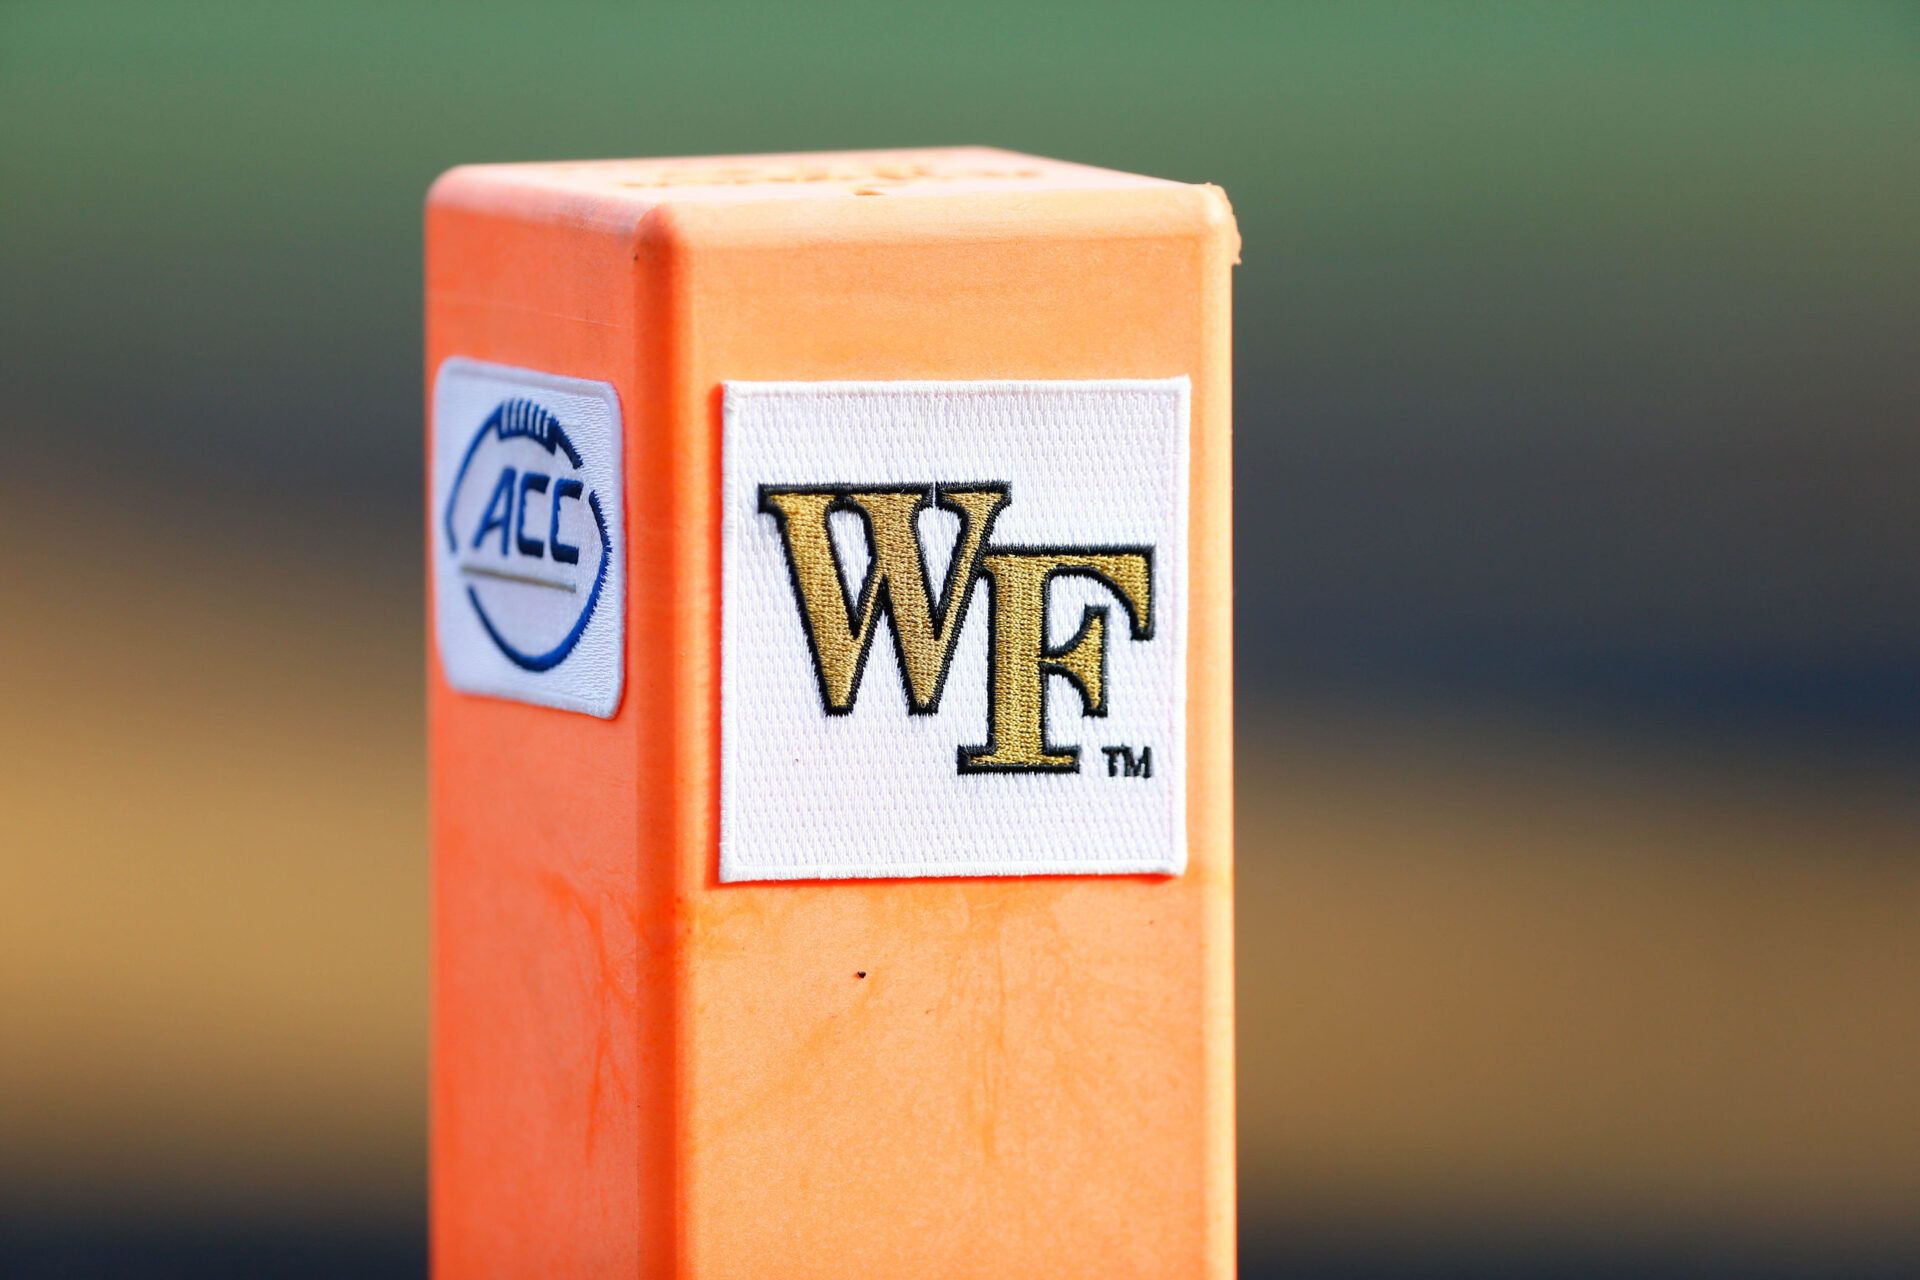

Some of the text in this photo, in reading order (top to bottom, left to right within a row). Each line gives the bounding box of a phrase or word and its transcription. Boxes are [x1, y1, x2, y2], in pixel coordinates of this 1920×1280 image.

[472, 466, 583, 565] ACC
[758, 480, 1156, 775] WF
[1101, 744, 1152, 778] TM
